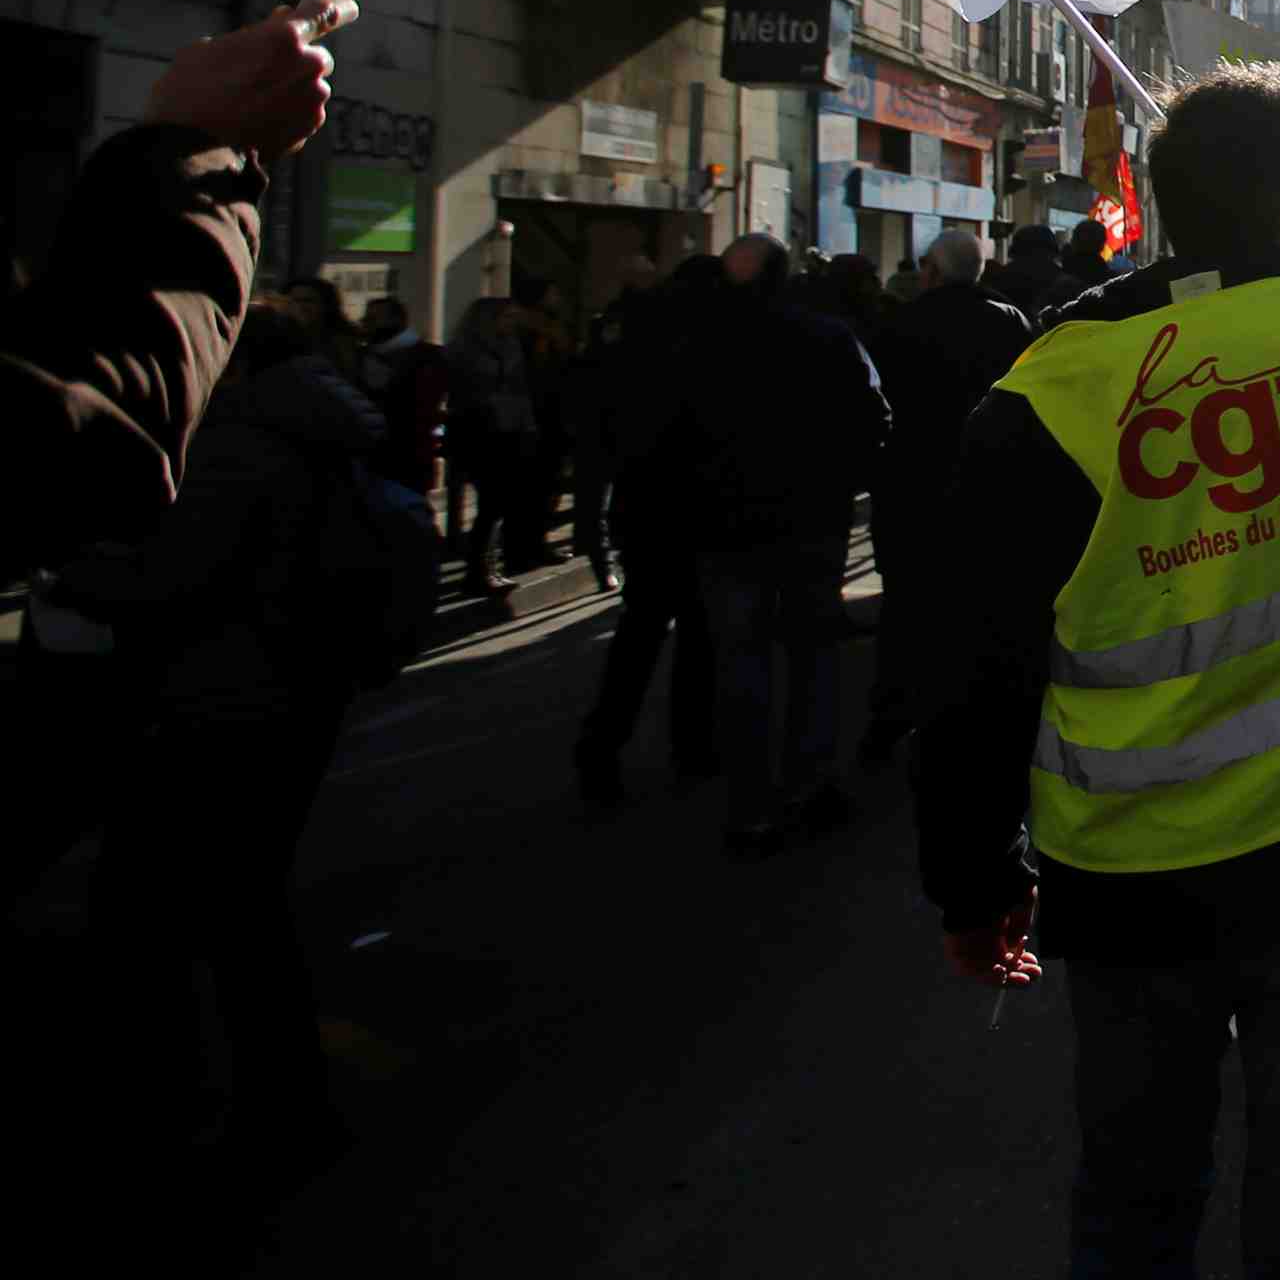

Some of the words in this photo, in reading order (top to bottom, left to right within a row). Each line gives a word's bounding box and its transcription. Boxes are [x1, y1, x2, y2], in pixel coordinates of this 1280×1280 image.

[730, 10, 820, 46] Métro
[1137, 526, 1240, 578] Bouches
[1246, 512, 1276, 548] du
